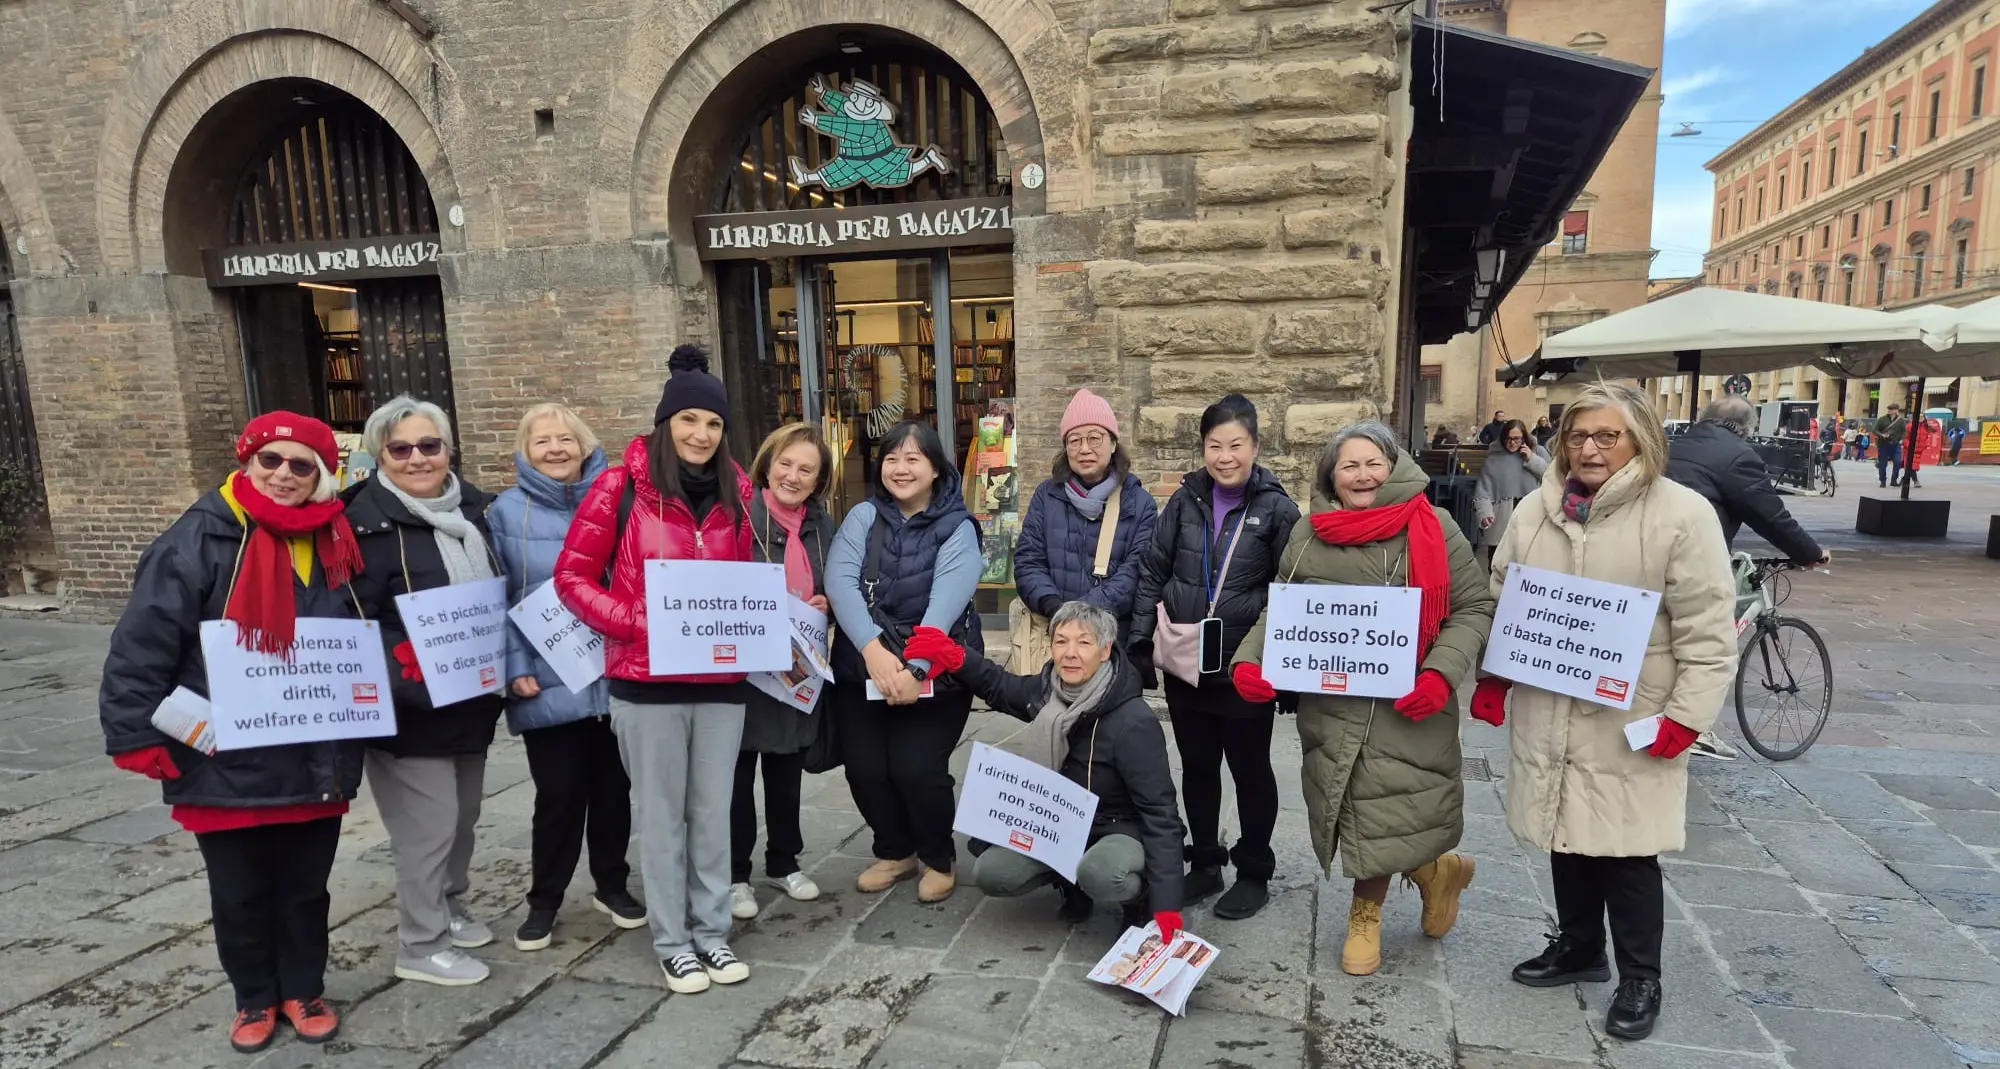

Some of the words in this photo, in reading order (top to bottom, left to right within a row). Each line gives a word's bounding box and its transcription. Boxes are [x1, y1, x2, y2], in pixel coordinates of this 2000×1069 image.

[708, 222, 834, 249] LIBRERIA
[836, 215, 890, 242] PER
[896, 205, 1010, 238] RAGAZZI
[223, 252, 318, 277] LIBRERIA
[316, 248, 359, 272] PER
[362, 241, 439, 267] RAGAZZ
[664, 596, 682, 611] La
[688, 596, 737, 611] nostra
[742, 595, 777, 612] forza
[1306, 598, 1325, 615] Le
[1330, 601, 1378, 617] mani
[1520, 579, 1546, 597] Non
[1550, 587, 1564, 600] ci
[1566, 591, 1612, 611] serve
[1615, 599, 1628, 615] il
[417, 614, 435, 628] Se
[439, 611, 448, 624] ti
[451, 602, 492, 625] picchia,
[1526, 607, 1596, 633] principe:
[424, 631, 470, 649] amore.
[543, 618, 581, 651] posse
[681, 620, 691, 637] è
[696, 620, 766, 637] collettiva
[799, 620, 813, 637] SPI
[1273, 625, 1360, 645] addosso?
[1365, 629, 1409, 648] Solo
[288, 635, 343, 651] olenza
[346, 634, 358, 651] si
[575, 646, 585, 659] il
[1502, 623, 1512, 636] ci
[1514, 625, 1552, 647] basta
[1556, 637, 1585, 655] che
[1589, 646, 1623, 664] non
[245, 661, 332, 679] combatte
[336, 662, 362, 675] con
[434, 661, 449, 675] lo
[452, 655, 477, 671] dice
[478, 652, 494, 664] sua
[1281, 655, 1302, 670] se
[1308, 653, 1390, 676] balliamo
[1509, 650, 1528, 664] sia
[1531, 657, 1552, 671] un
[1556, 663, 1592, 681] orco
[282, 685, 337, 702] diritti,
[234, 711, 308, 731] welfare
[312, 712, 324, 724] e
[328, 707, 381, 724] cultura
[977, 762, 983, 773] I
[984, 765, 1019, 786] diritti
[1021, 779, 1050, 799] delle
[1052, 793, 1086, 819] donne
[998, 790, 1025, 807] non
[1028, 803, 1060, 823] sono
[988, 807, 1061, 845] negoziabili
